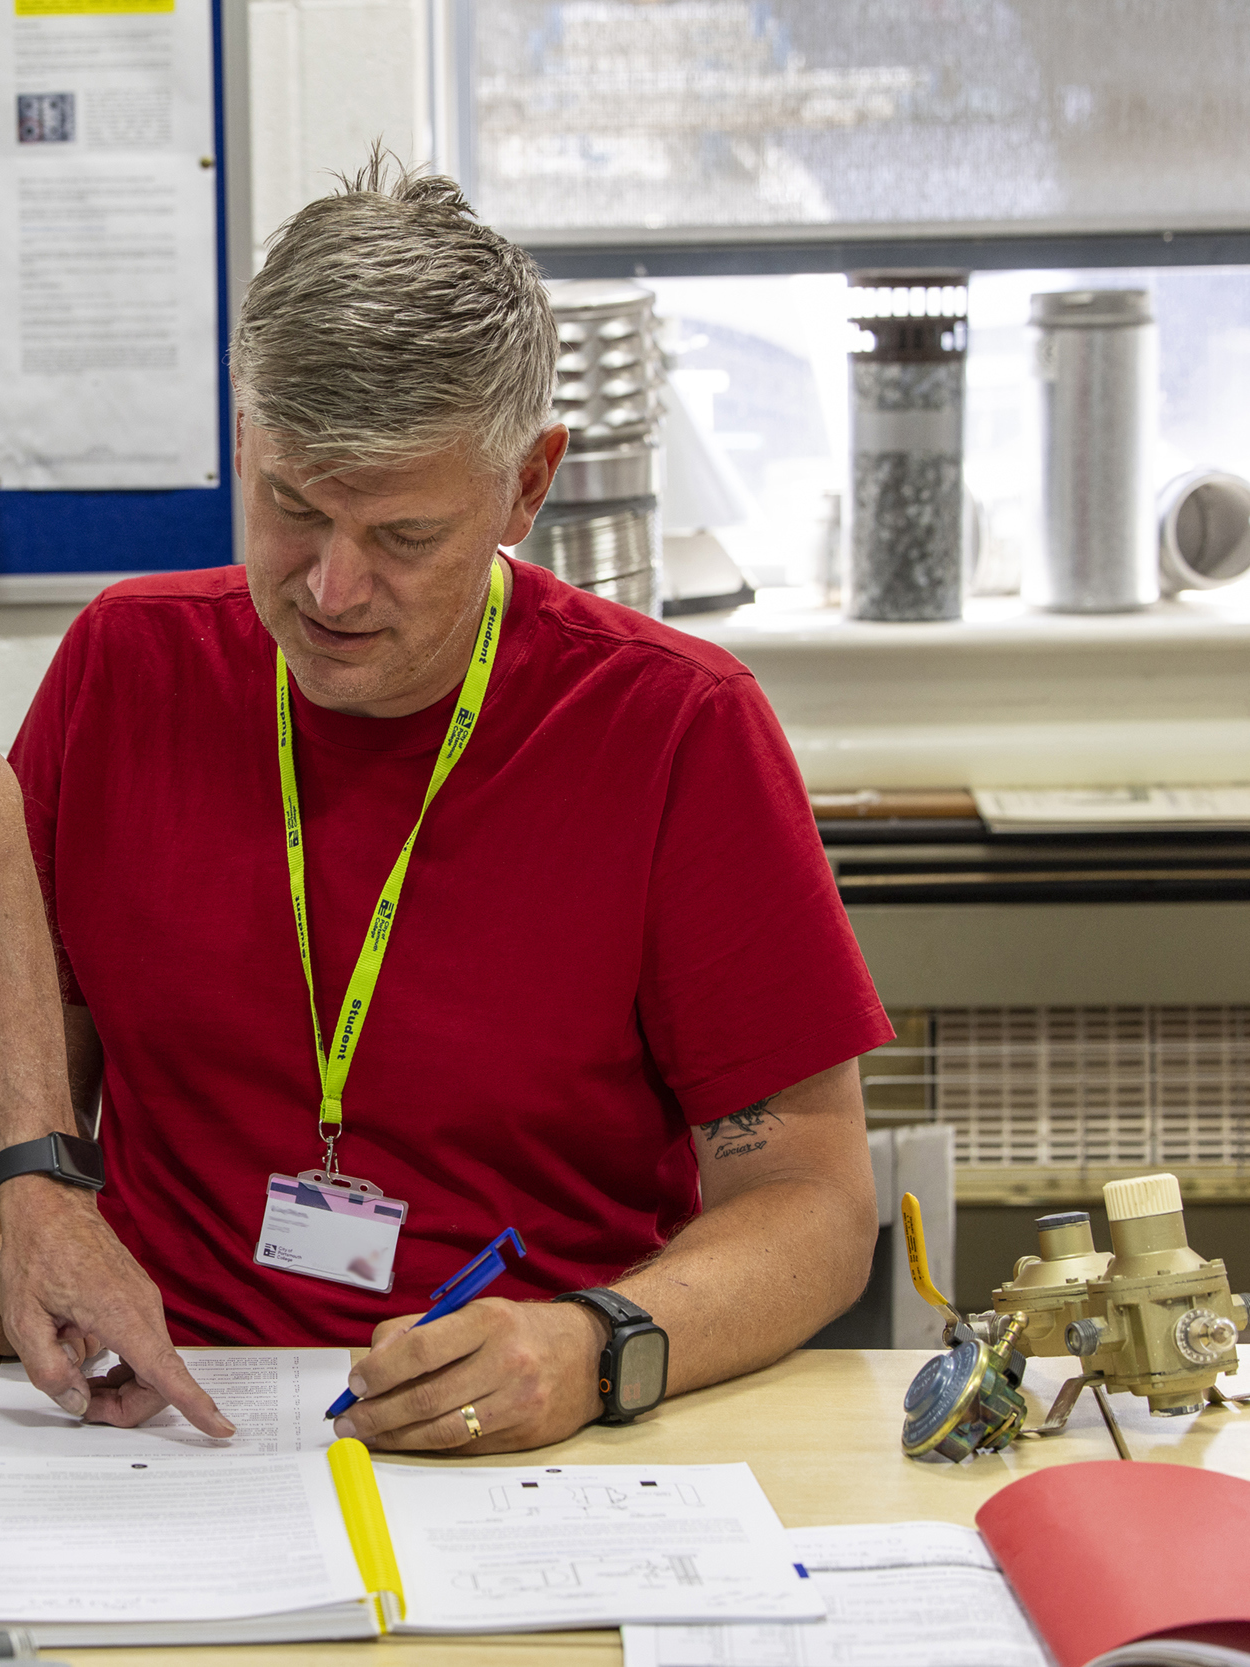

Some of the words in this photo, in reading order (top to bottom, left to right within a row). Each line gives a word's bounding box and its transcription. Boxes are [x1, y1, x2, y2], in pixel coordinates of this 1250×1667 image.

[479, 605, 497, 664] Student
[370, 917, 381, 938] College
[337, 999, 362, 1060] Student
